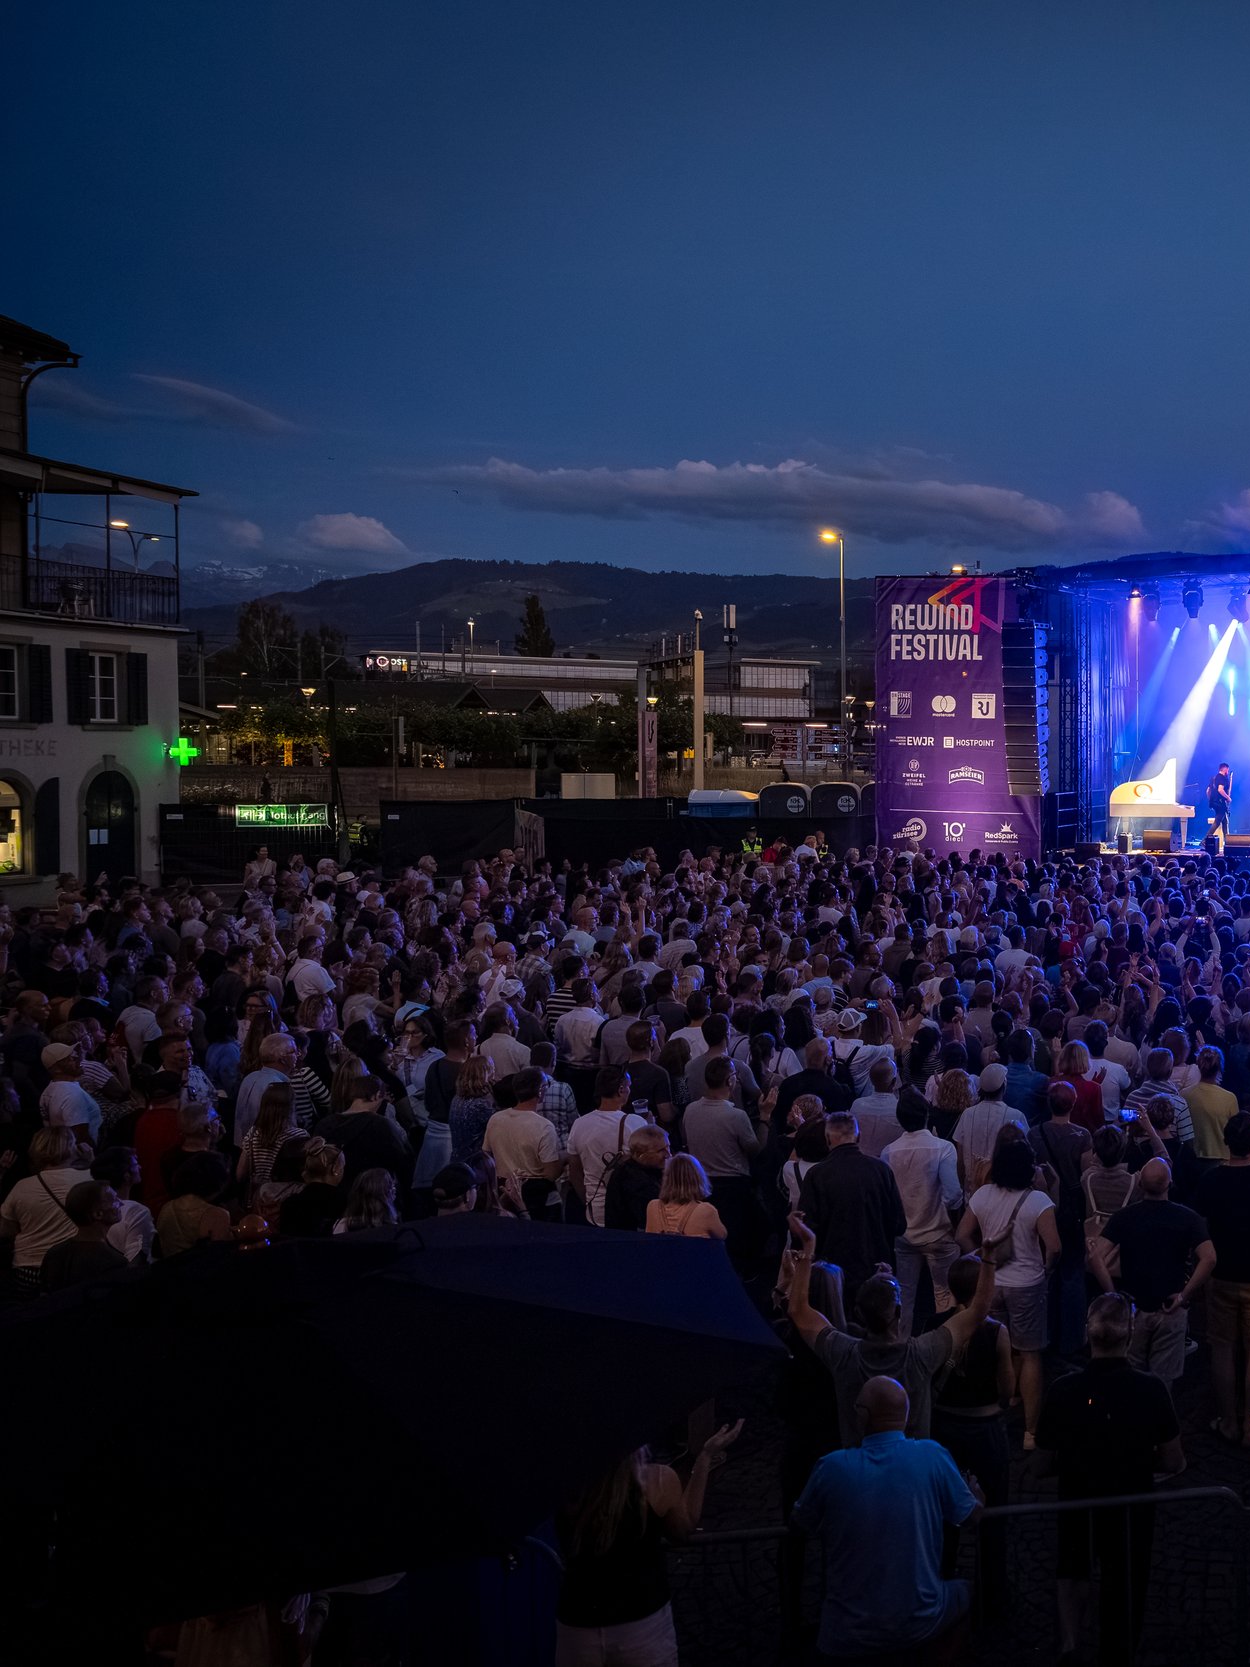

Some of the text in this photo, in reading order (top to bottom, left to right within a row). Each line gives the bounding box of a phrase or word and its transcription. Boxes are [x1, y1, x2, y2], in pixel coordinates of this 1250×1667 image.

[891, 604, 974, 630] REWIND
[890, 634, 983, 661] FESTIVAL
[906, 736, 935, 747] EWJR
[955, 739, 995, 747] HOSTPOINT
[950, 771, 982, 781] RAMSEIER
[902, 824, 921, 833] radio
[893, 830, 918, 840] zürisee
[984, 832, 1018, 840] RedSpark
